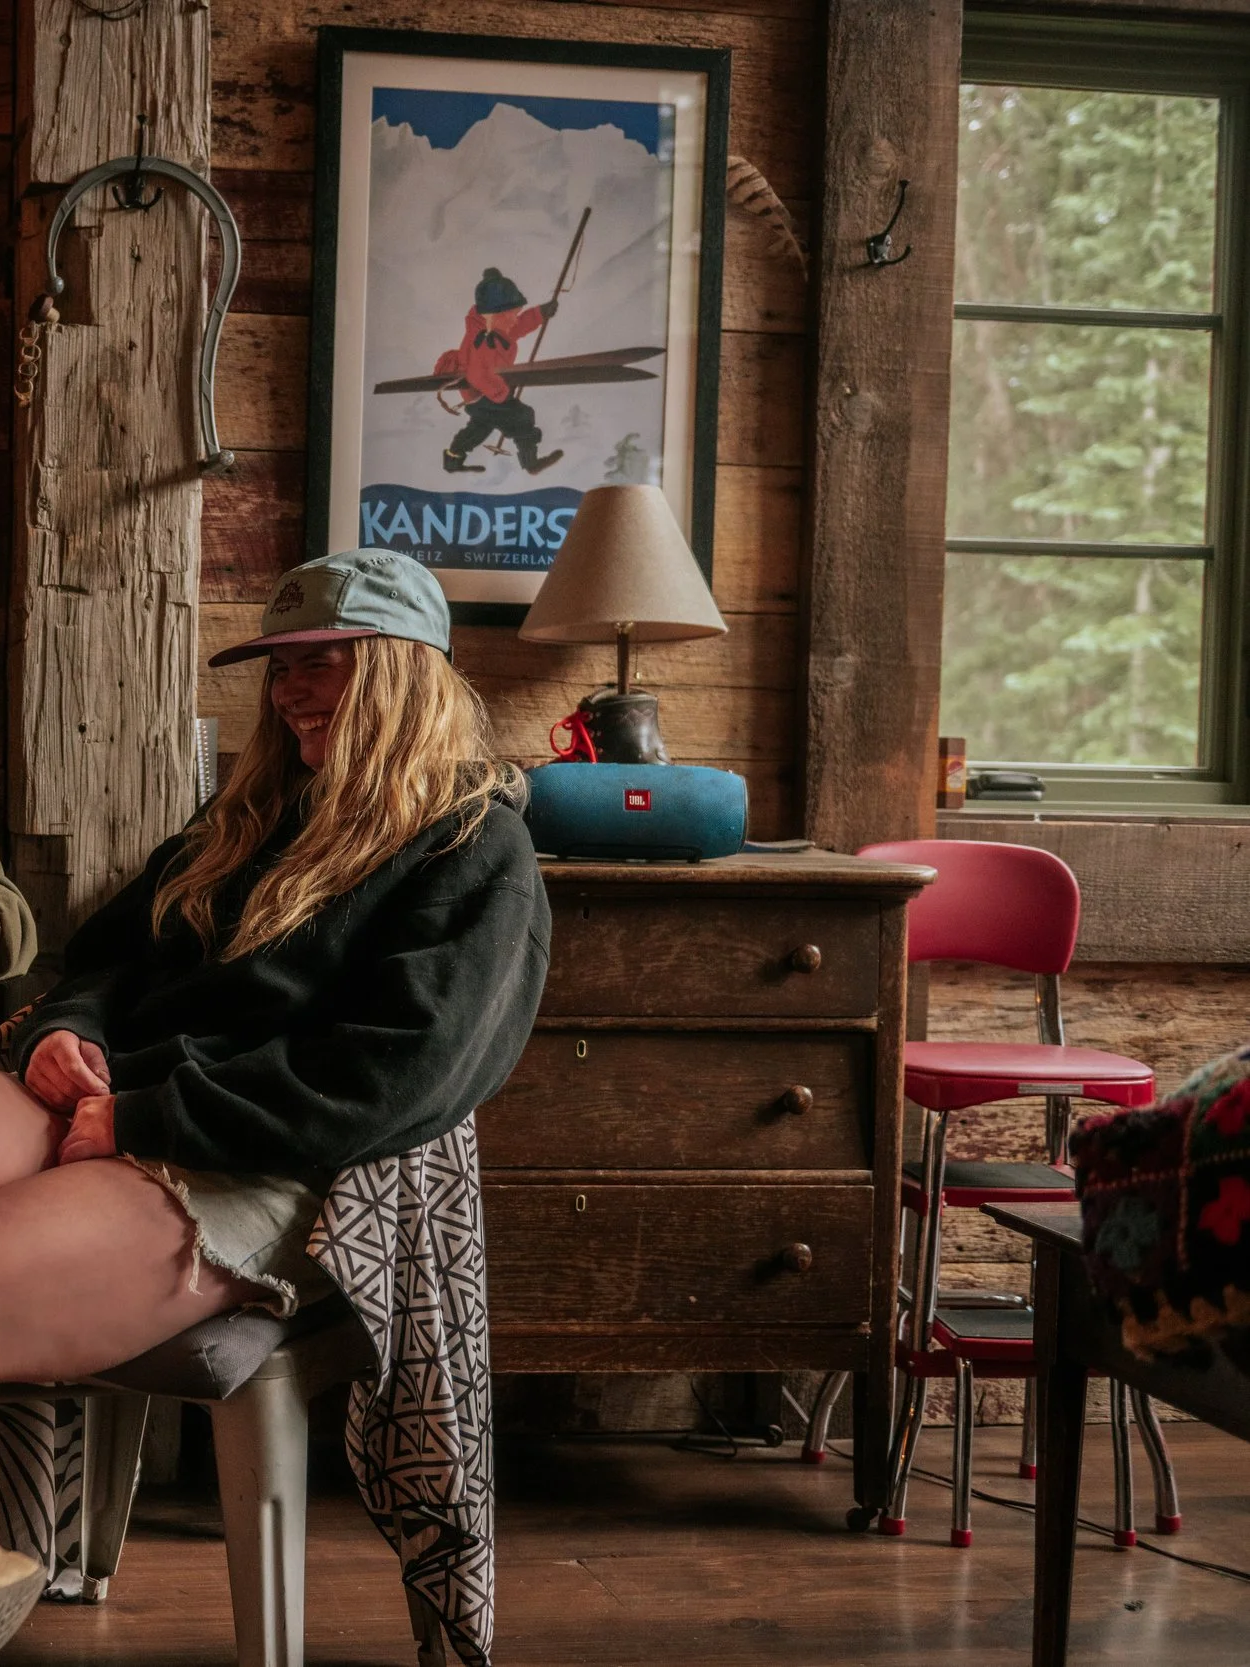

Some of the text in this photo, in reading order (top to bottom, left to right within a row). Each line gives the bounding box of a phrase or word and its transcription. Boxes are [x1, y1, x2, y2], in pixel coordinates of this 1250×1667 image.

[360, 500, 578, 550] KANDERS
[402, 549, 557, 566] WEIZ SWITZERLAN
[629, 795, 645, 806] JBL
